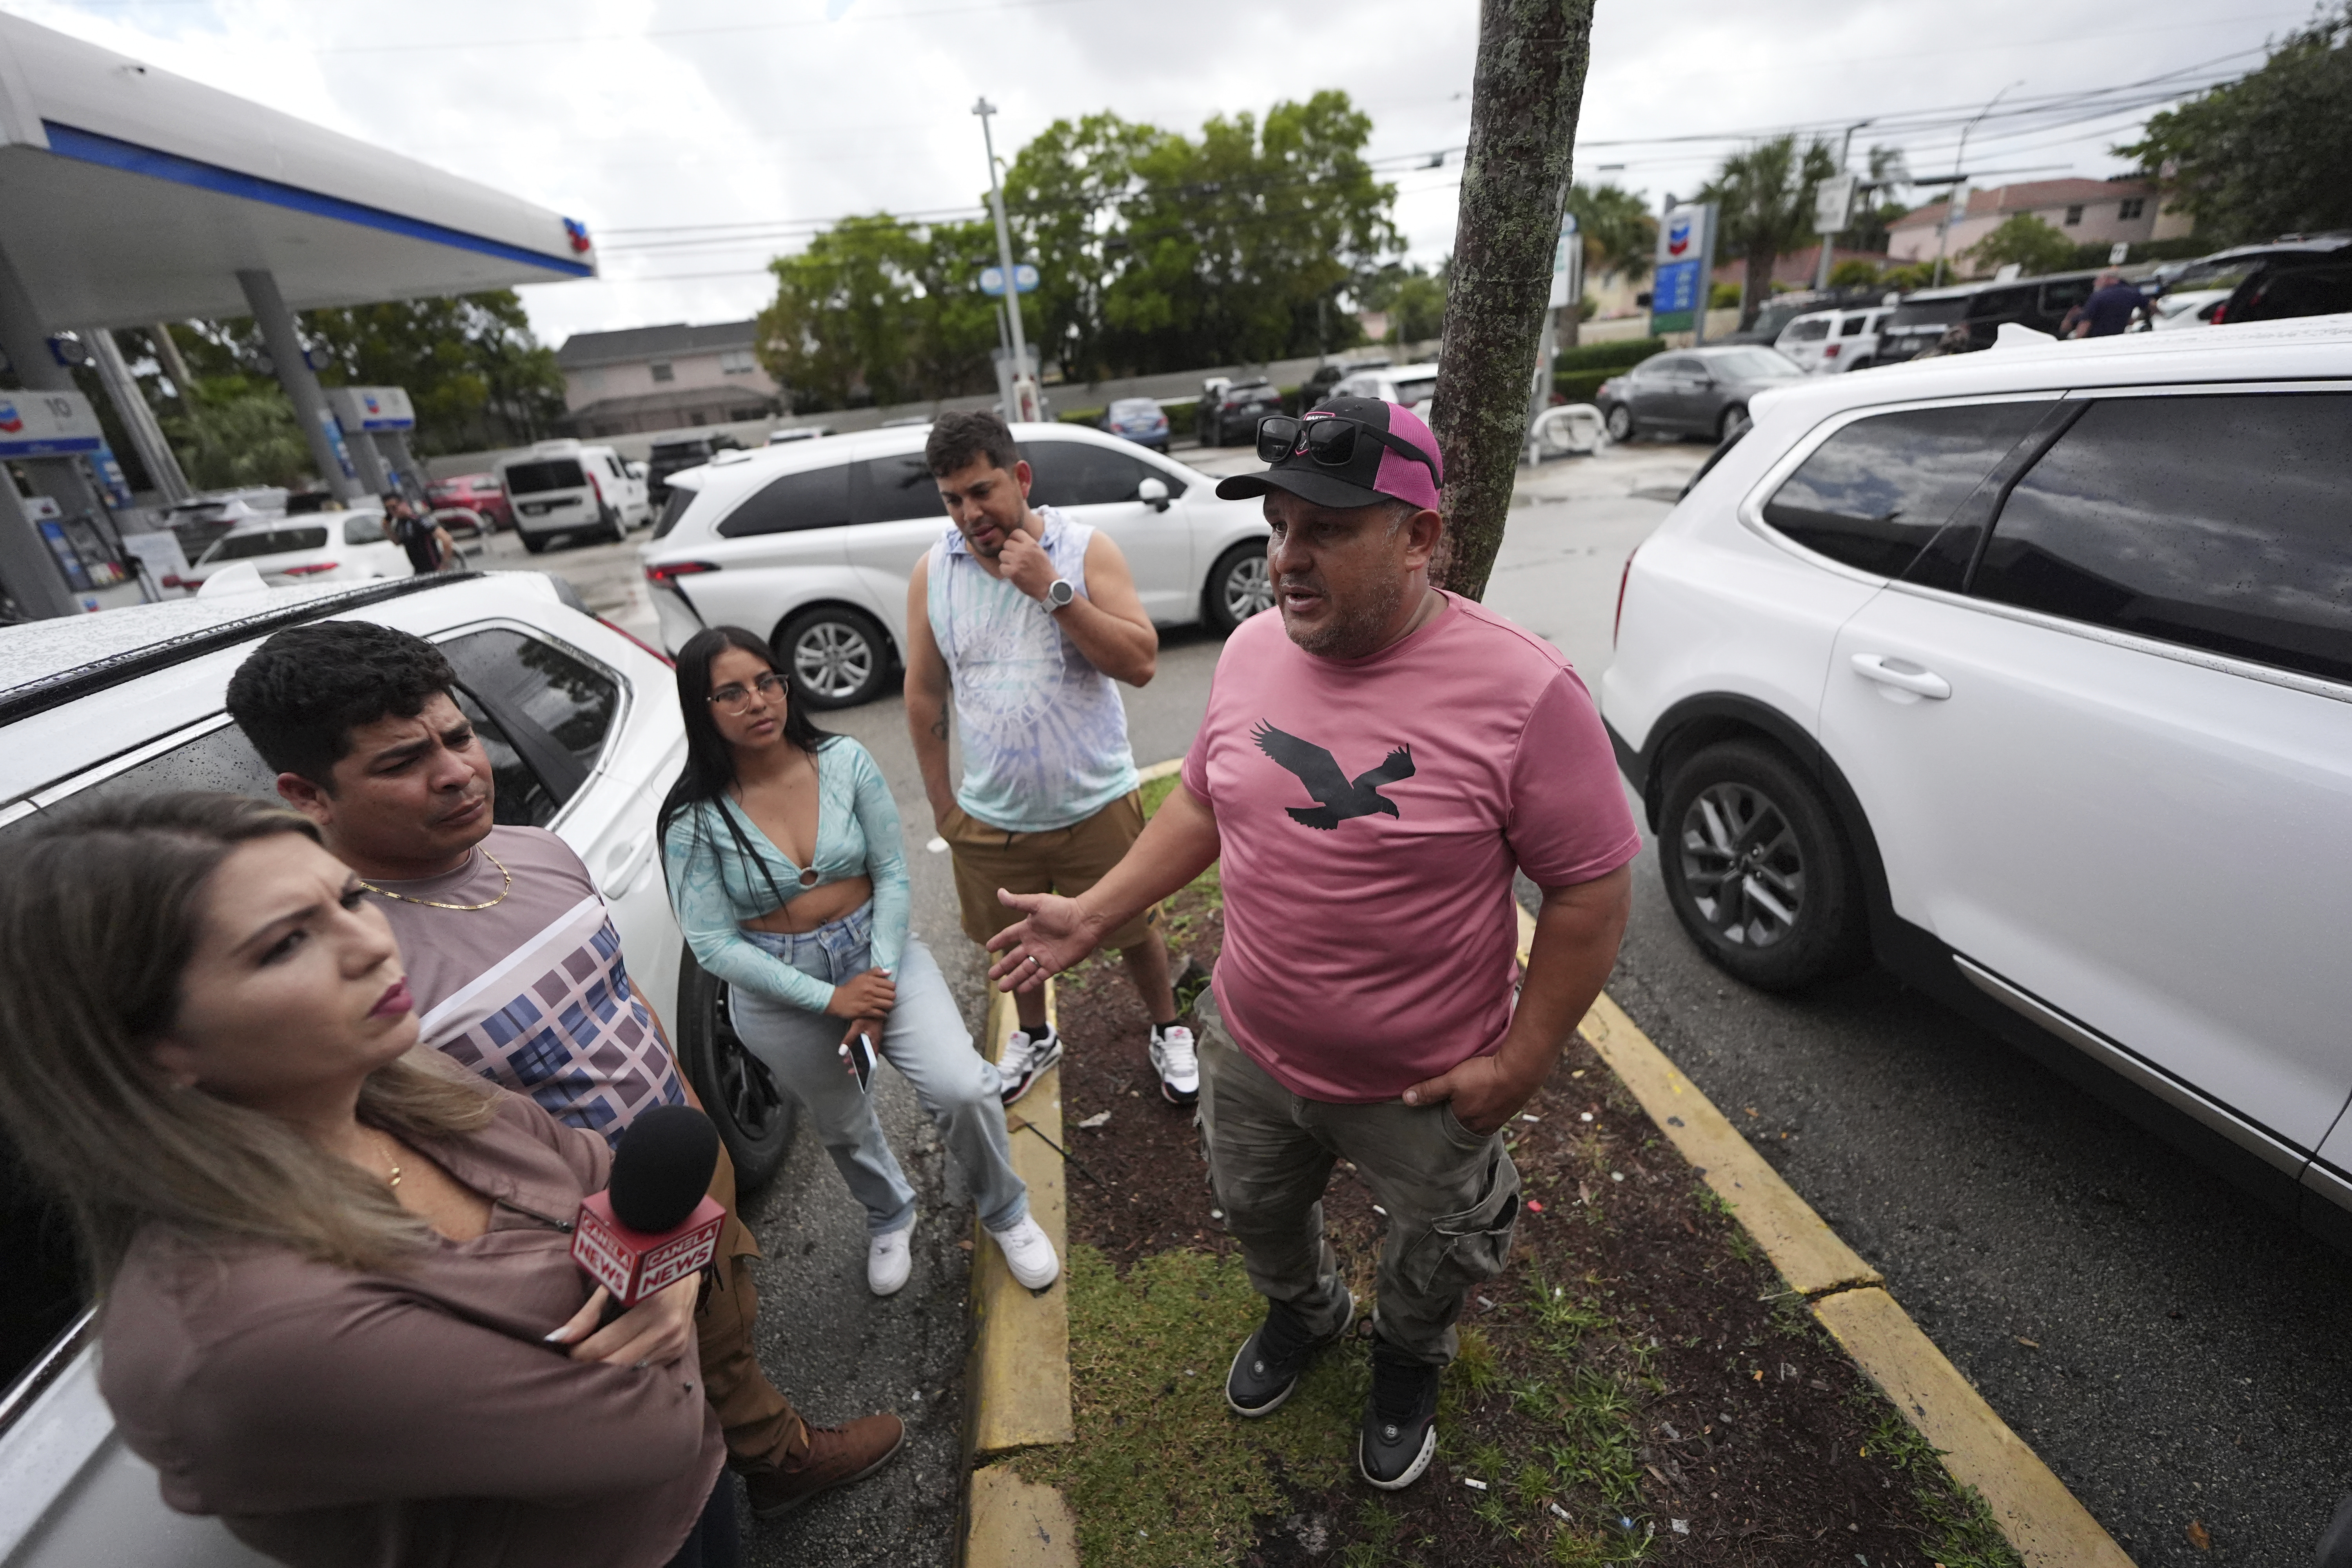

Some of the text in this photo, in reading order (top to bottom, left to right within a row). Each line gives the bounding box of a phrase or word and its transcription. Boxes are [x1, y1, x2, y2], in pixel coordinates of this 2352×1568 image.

[44, 397, 72, 418] 10
[578, 1238, 625, 1290] NEWS
[582, 1218, 630, 1271] CANELA
[648, 1228, 714, 1268] CANELA
[642, 1245, 710, 1292] NEWS
